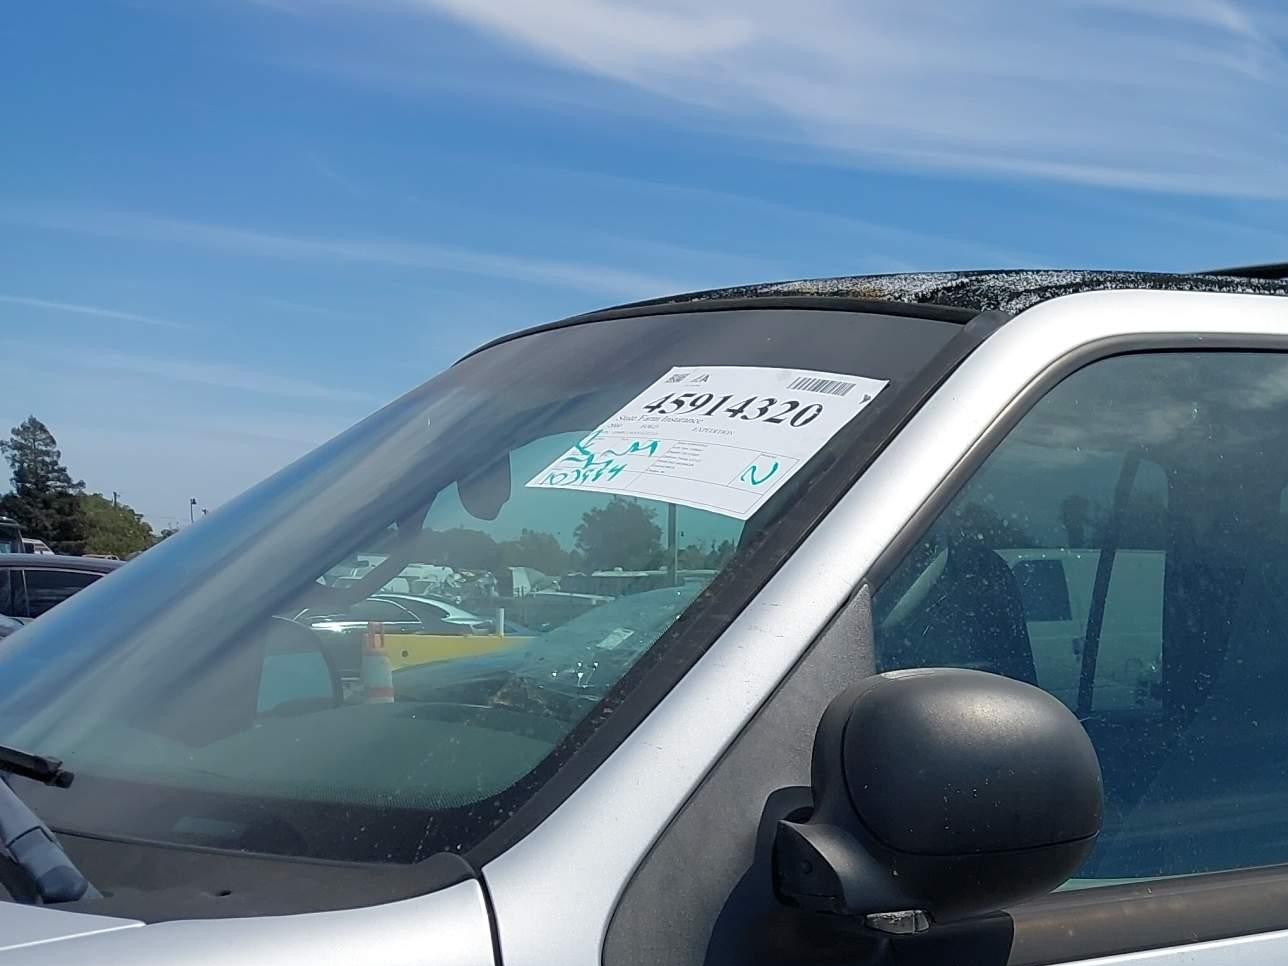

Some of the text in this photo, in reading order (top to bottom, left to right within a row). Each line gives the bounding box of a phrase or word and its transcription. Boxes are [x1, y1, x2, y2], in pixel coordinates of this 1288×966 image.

[643, 392, 824, 428] 45914320
[638, 414, 661, 423] Farm
[661, 415, 704, 425] Insurance
[691, 426, 736, 437] EXPEDITION
